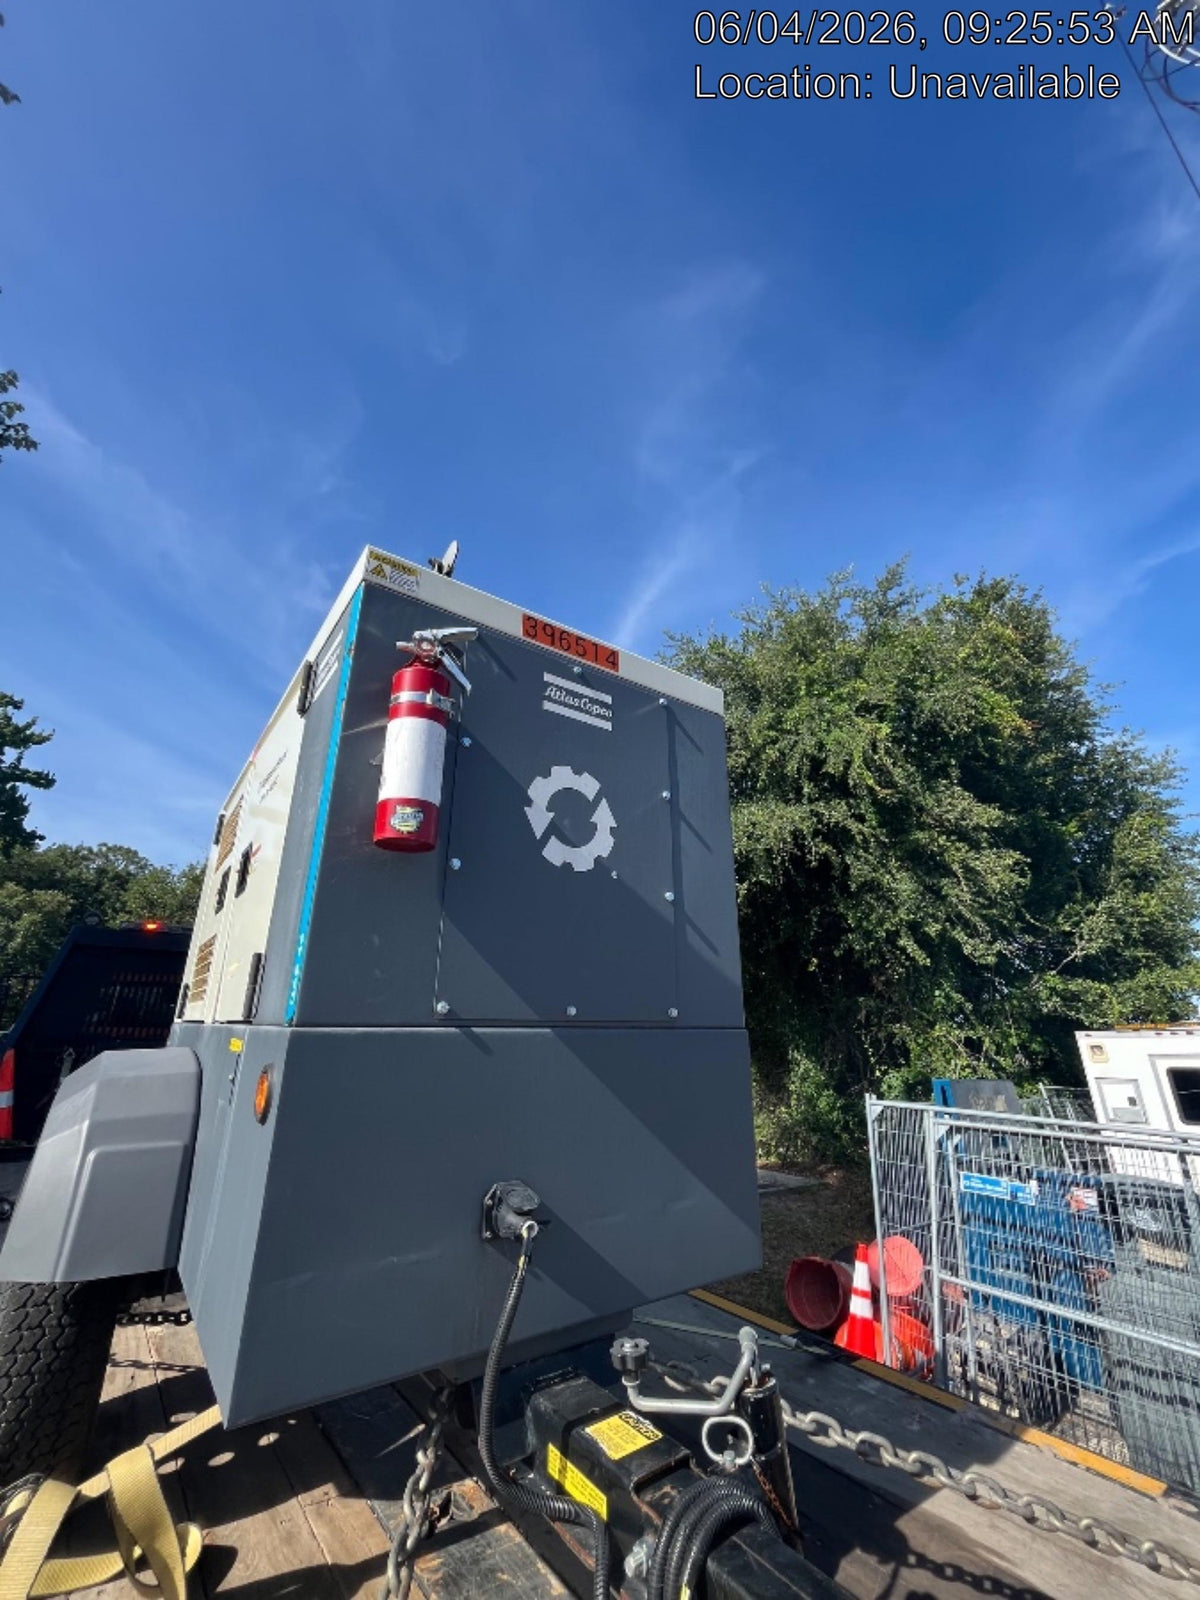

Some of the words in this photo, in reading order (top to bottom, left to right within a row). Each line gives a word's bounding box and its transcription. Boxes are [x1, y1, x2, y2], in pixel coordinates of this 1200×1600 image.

[525, 616, 618, 667] 396514
[545, 686, 580, 707] Atlas
[581, 698, 613, 718] Copco
